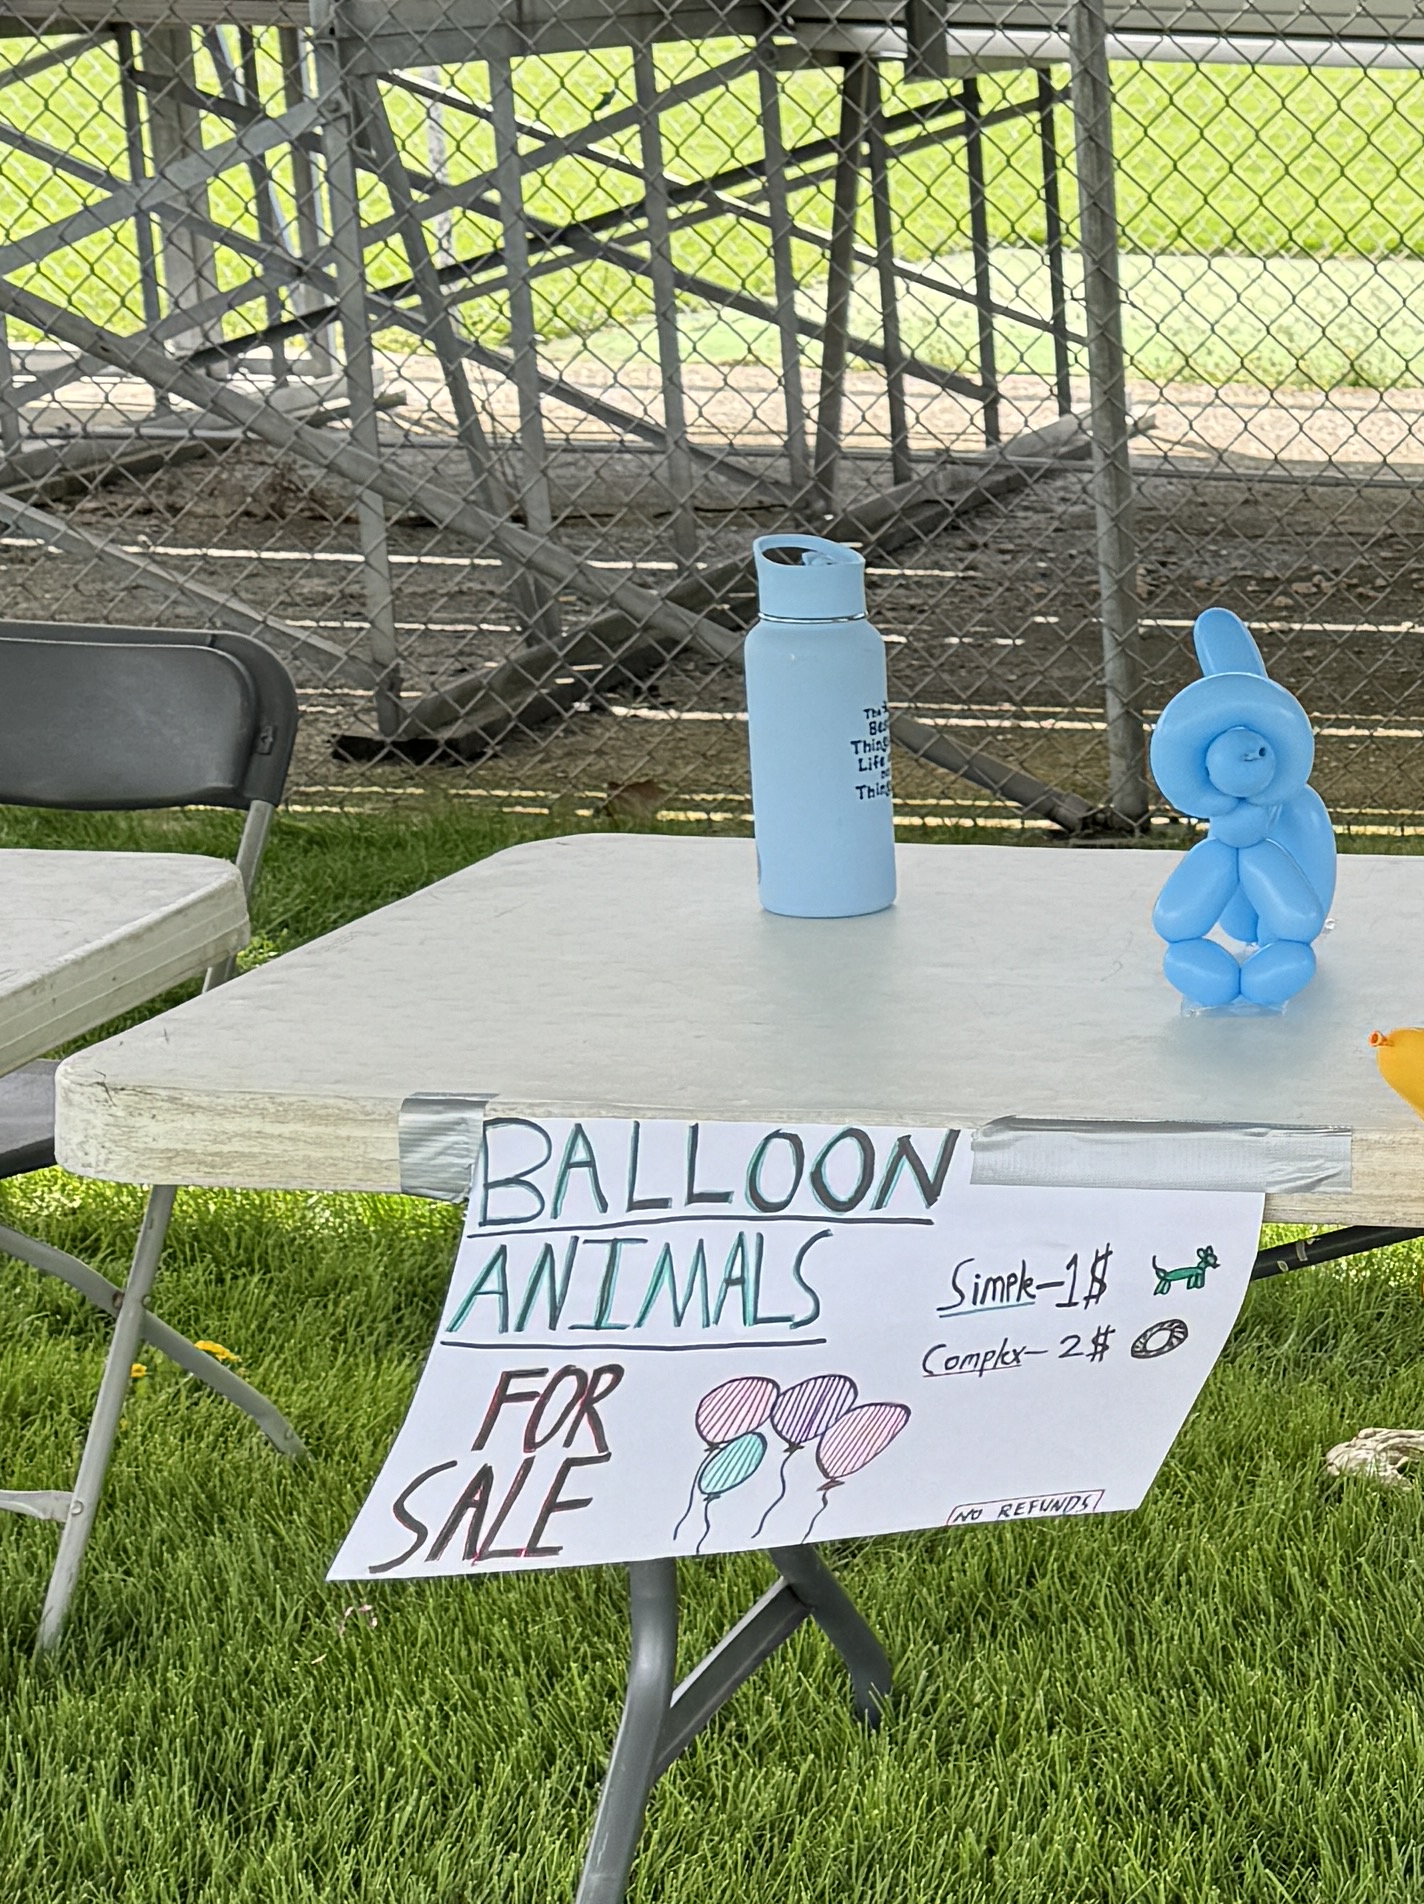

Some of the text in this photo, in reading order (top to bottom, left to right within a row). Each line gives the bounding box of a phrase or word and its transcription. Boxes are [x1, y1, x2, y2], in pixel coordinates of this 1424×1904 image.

[479, 1116, 961, 1227] BALLOON
[445, 1228, 834, 1333] ANIMALS
[470, 1363, 625, 1454] FOR
[368, 1452, 611, 1573] SALE
[953, 1494, 1091, 1524] NO REFUNDS
